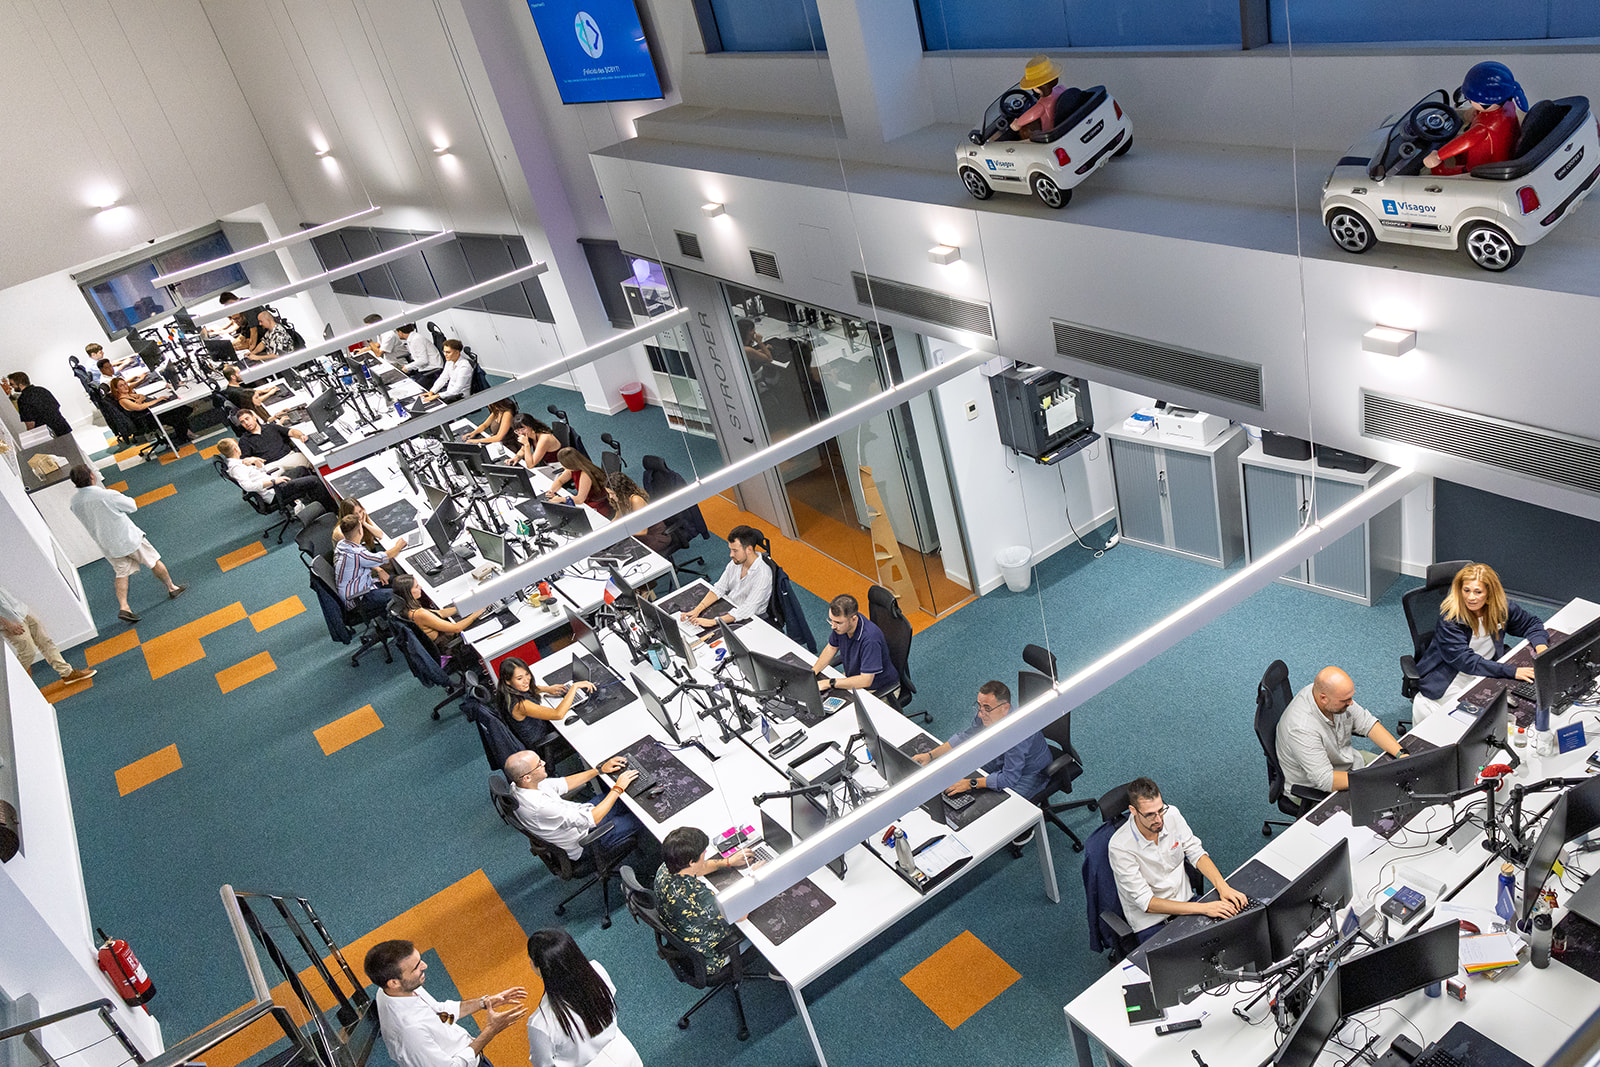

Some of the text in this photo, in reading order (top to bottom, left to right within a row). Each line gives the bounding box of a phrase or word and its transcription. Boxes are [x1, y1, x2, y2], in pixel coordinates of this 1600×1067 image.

[993, 160, 1015, 168] Visagov
[1397, 201, 1436, 213] Visagov
[698, 311, 741, 430] STROPER
